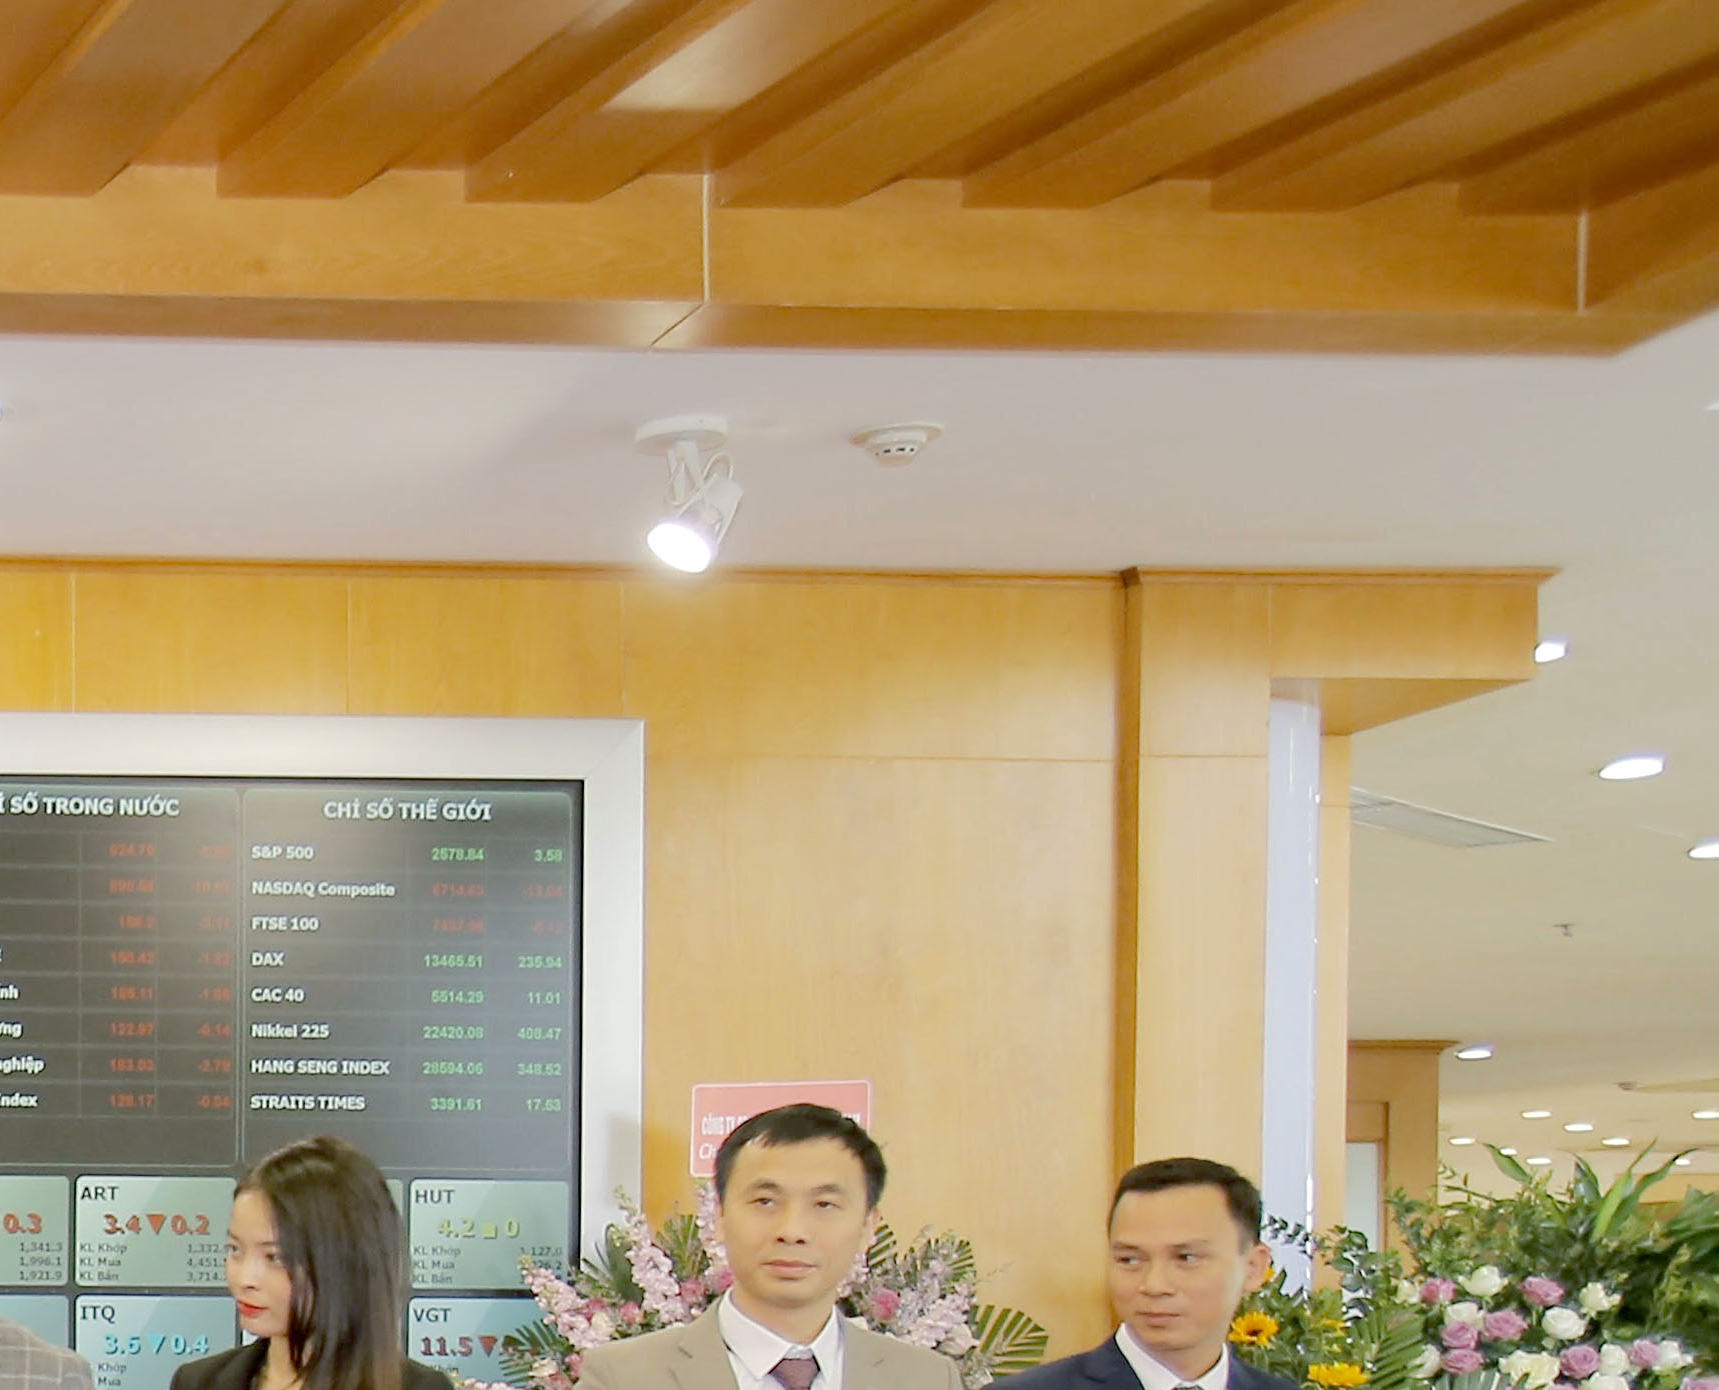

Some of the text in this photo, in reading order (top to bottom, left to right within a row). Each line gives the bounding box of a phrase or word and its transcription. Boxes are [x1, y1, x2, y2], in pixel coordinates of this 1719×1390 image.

[43, 798, 114, 816] TRONG
[118, 793, 180, 816] NƯỚC
[251, 846, 314, 860] S&P 500
[252, 883, 395, 898] NASDAQ Composite
[251, 917, 319, 931] FTSE 100
[251, 953, 284, 966] DAX
[251, 989, 304, 1002] CAC 40
[301, 1025, 329, 1038] 225
[251, 1061, 390, 1075] HANG SENG INDEX
[250, 1096, 366, 1110] STRAITS TIMES
[81, 1186, 119, 1200] ART
[415, 1189, 455, 1203] HUT
[104, 1214, 210, 1235] 3.4 0.2
[413, 1308, 451, 1322] VGT
